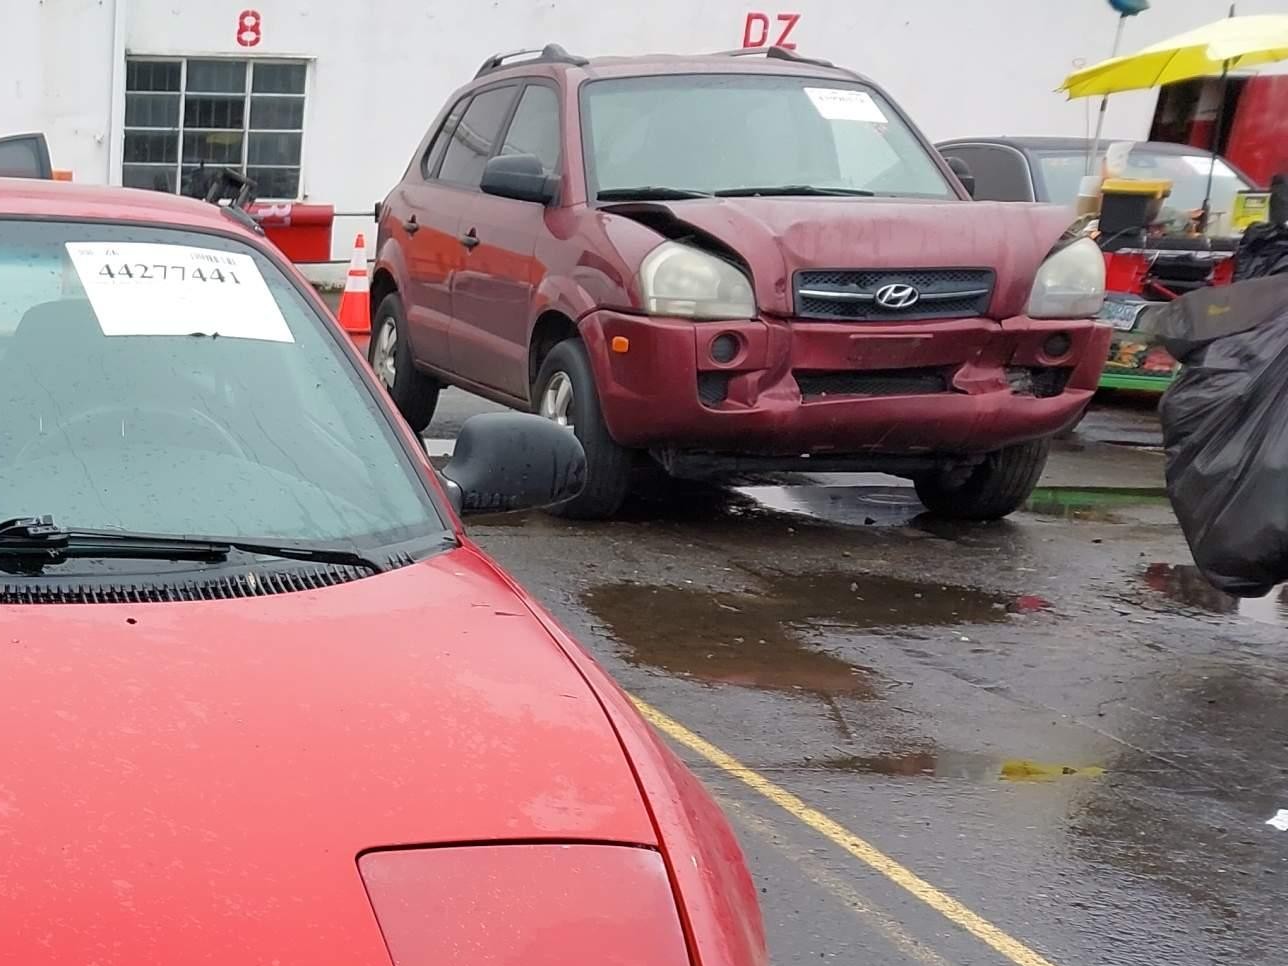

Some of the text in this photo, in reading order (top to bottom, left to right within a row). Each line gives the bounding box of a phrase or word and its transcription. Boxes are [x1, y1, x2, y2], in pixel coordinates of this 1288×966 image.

[237, 10, 261, 47] 8
[743, 12, 800, 50] DZ
[98, 263, 241, 285] 44277441
